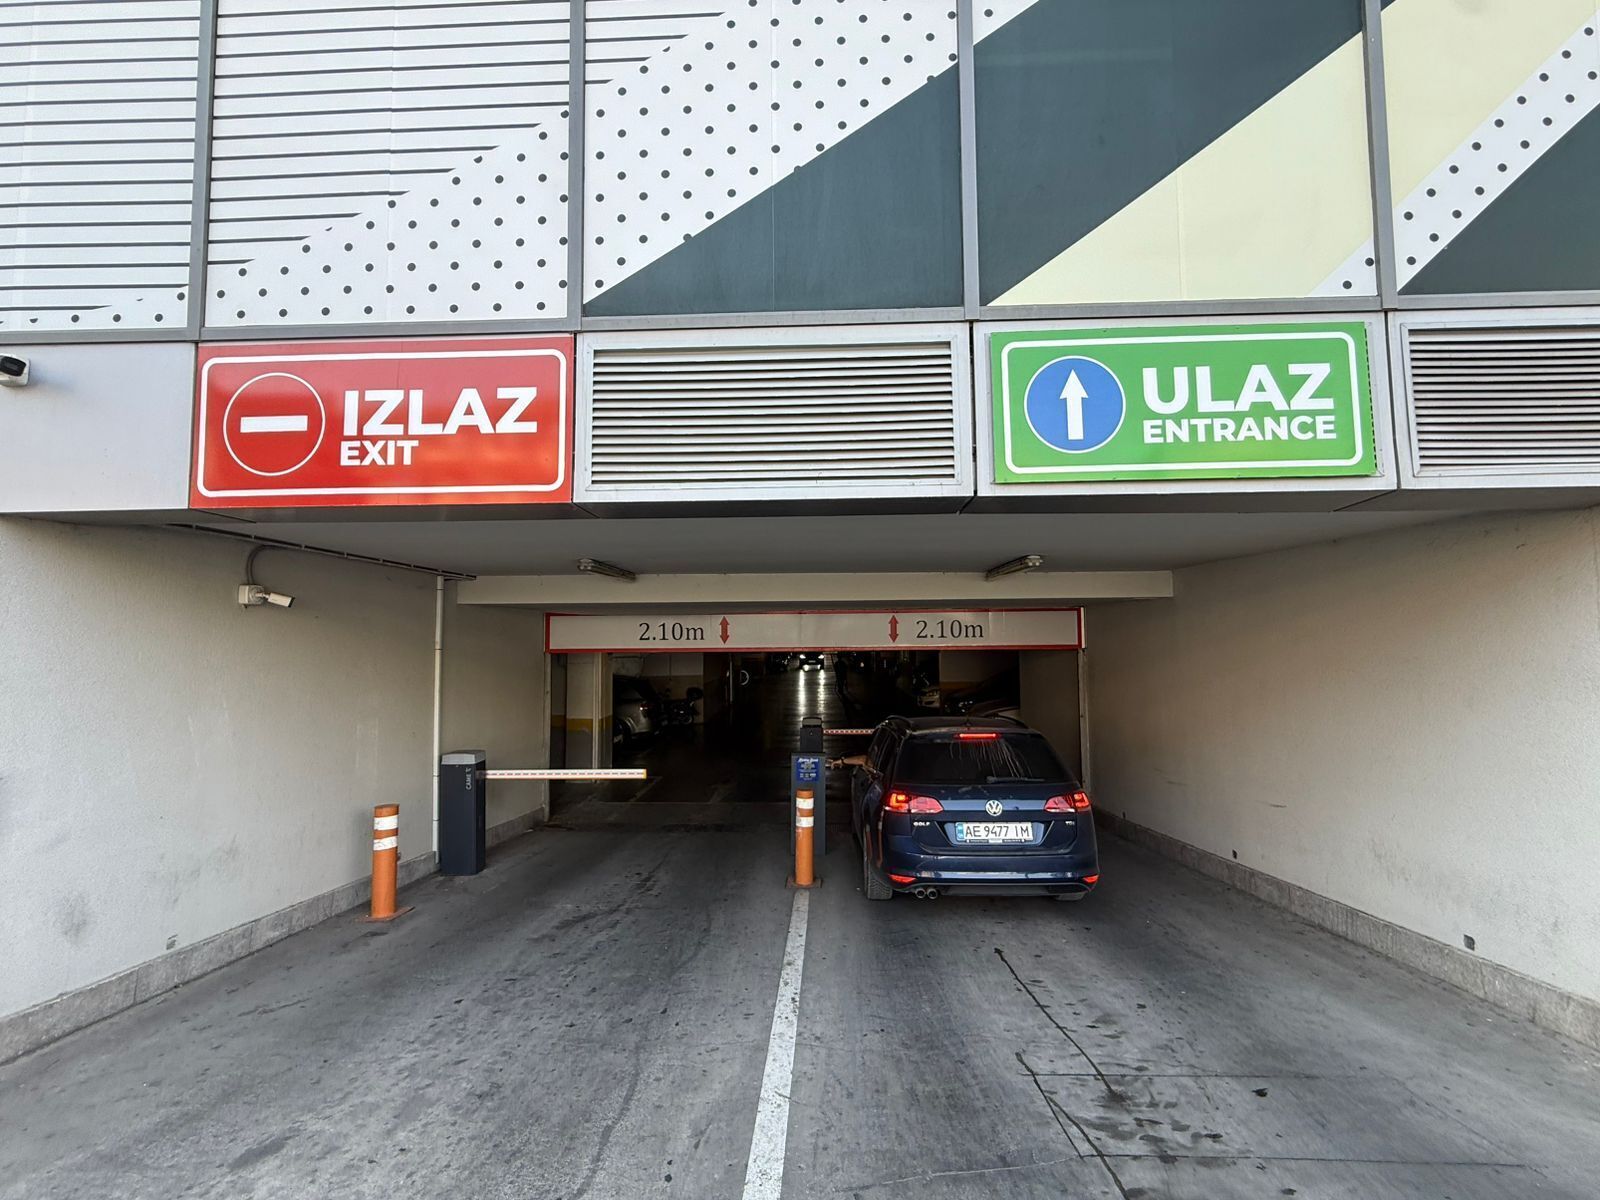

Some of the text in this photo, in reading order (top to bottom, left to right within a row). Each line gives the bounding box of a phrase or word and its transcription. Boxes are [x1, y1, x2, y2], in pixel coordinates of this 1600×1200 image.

[1142, 362, 1335, 414] ULAZ
[342, 387, 538, 436] IZLAZ
[1143, 415, 1337, 444] ENTRANCE
[340, 439, 419, 466] EXIT
[639, 622, 705, 641] 2.10m
[916, 619, 984, 639] 2.10m
[965, 825, 981, 838] AE
[983, 825, 1009, 838] 9477
[1014, 825, 1030, 838] IM
